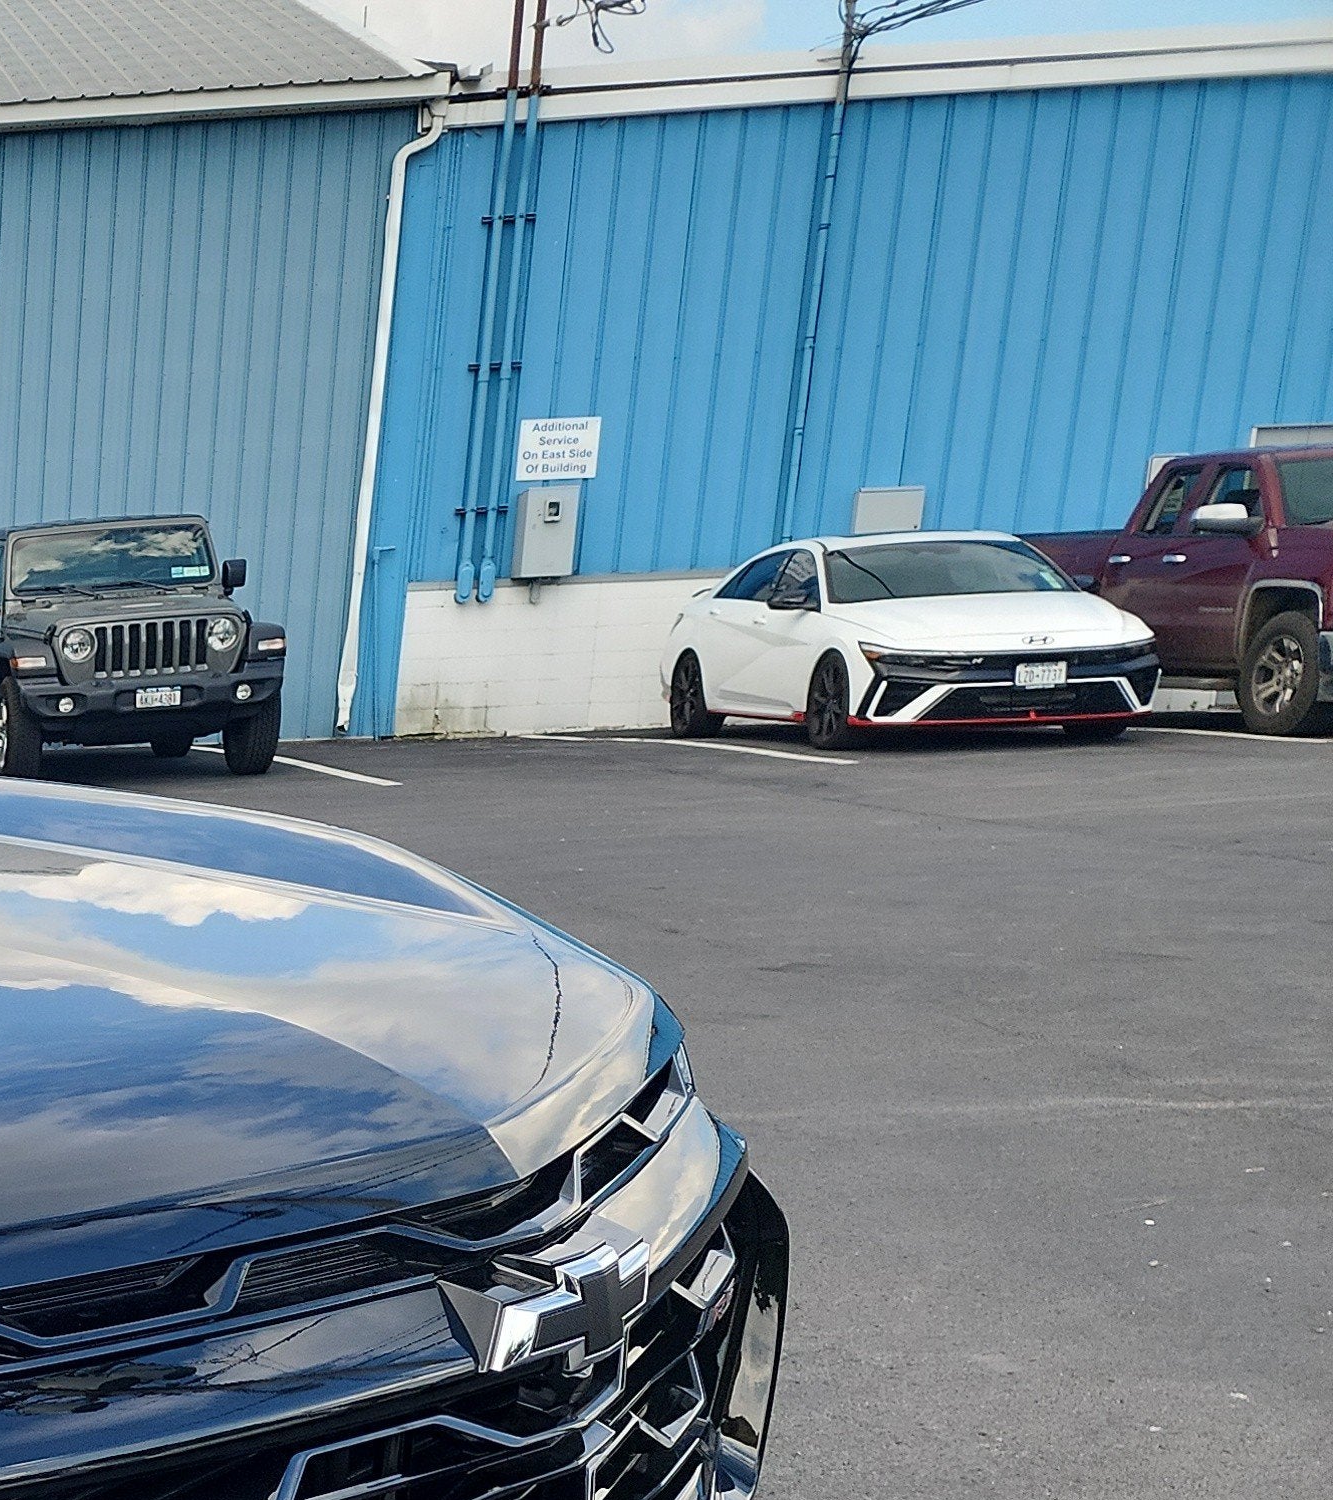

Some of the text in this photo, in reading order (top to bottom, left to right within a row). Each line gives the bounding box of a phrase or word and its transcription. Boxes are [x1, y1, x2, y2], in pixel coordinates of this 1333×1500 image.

[533, 421, 589, 432] Additional
[539, 436, 579, 446] Service
[522, 449, 593, 460] On East Side
[525, 463, 587, 474] Of Building
